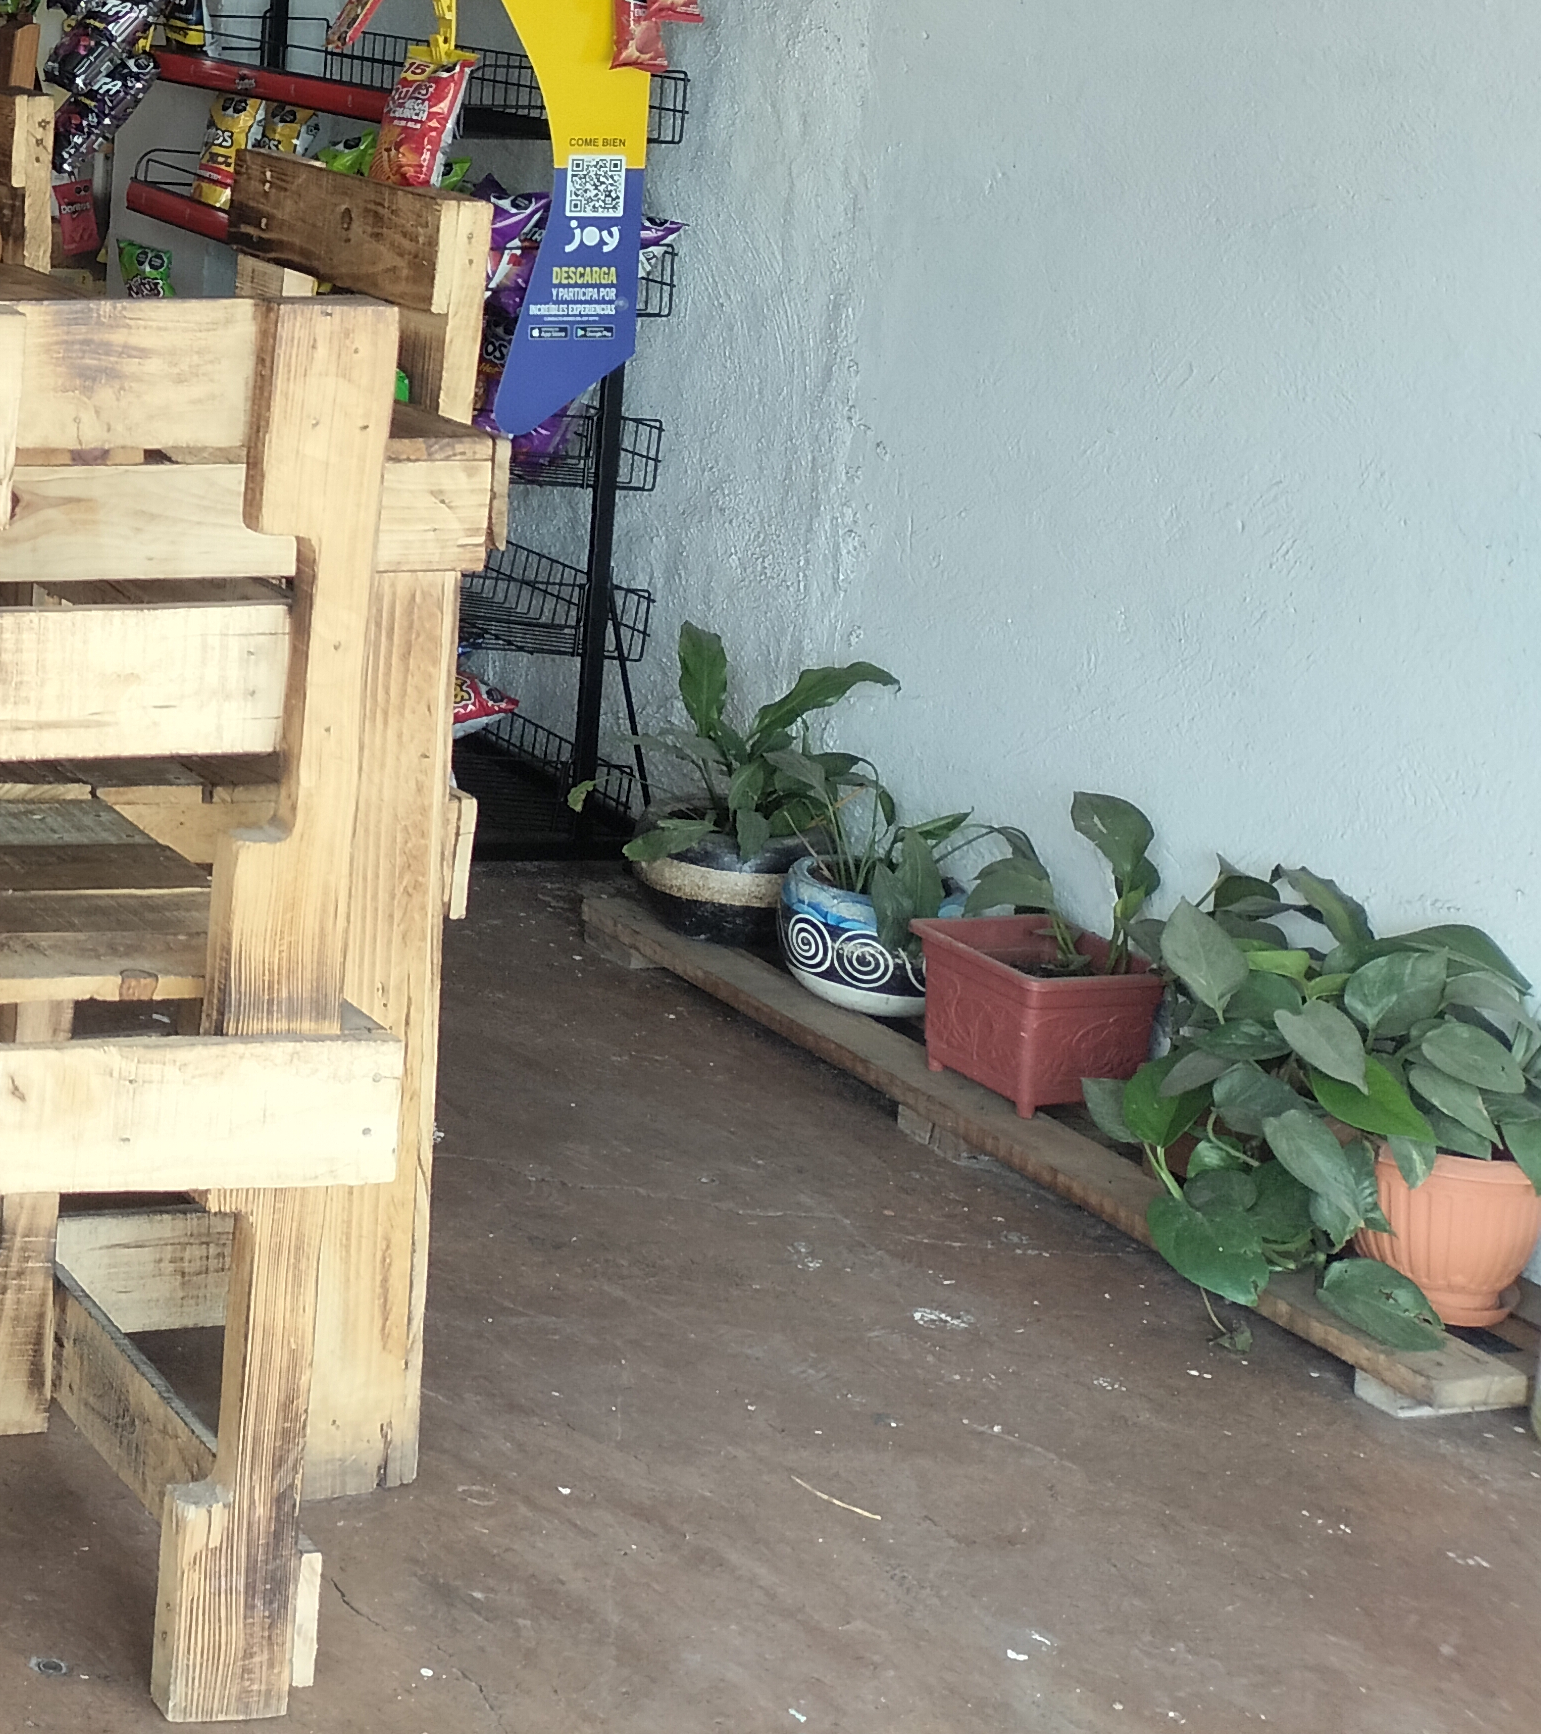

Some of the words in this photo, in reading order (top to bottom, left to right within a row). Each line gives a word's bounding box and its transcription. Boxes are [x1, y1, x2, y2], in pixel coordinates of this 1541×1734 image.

[403, 61, 431, 76] 15
[569, 137, 600, 147] COME
[602, 137, 626, 147] BIEN
[564, 219, 621, 253] joy
[552, 267, 617, 284] DESCARGA
[558, 288, 598, 300] PARTICIPA
[599, 288, 616, 300] POR
